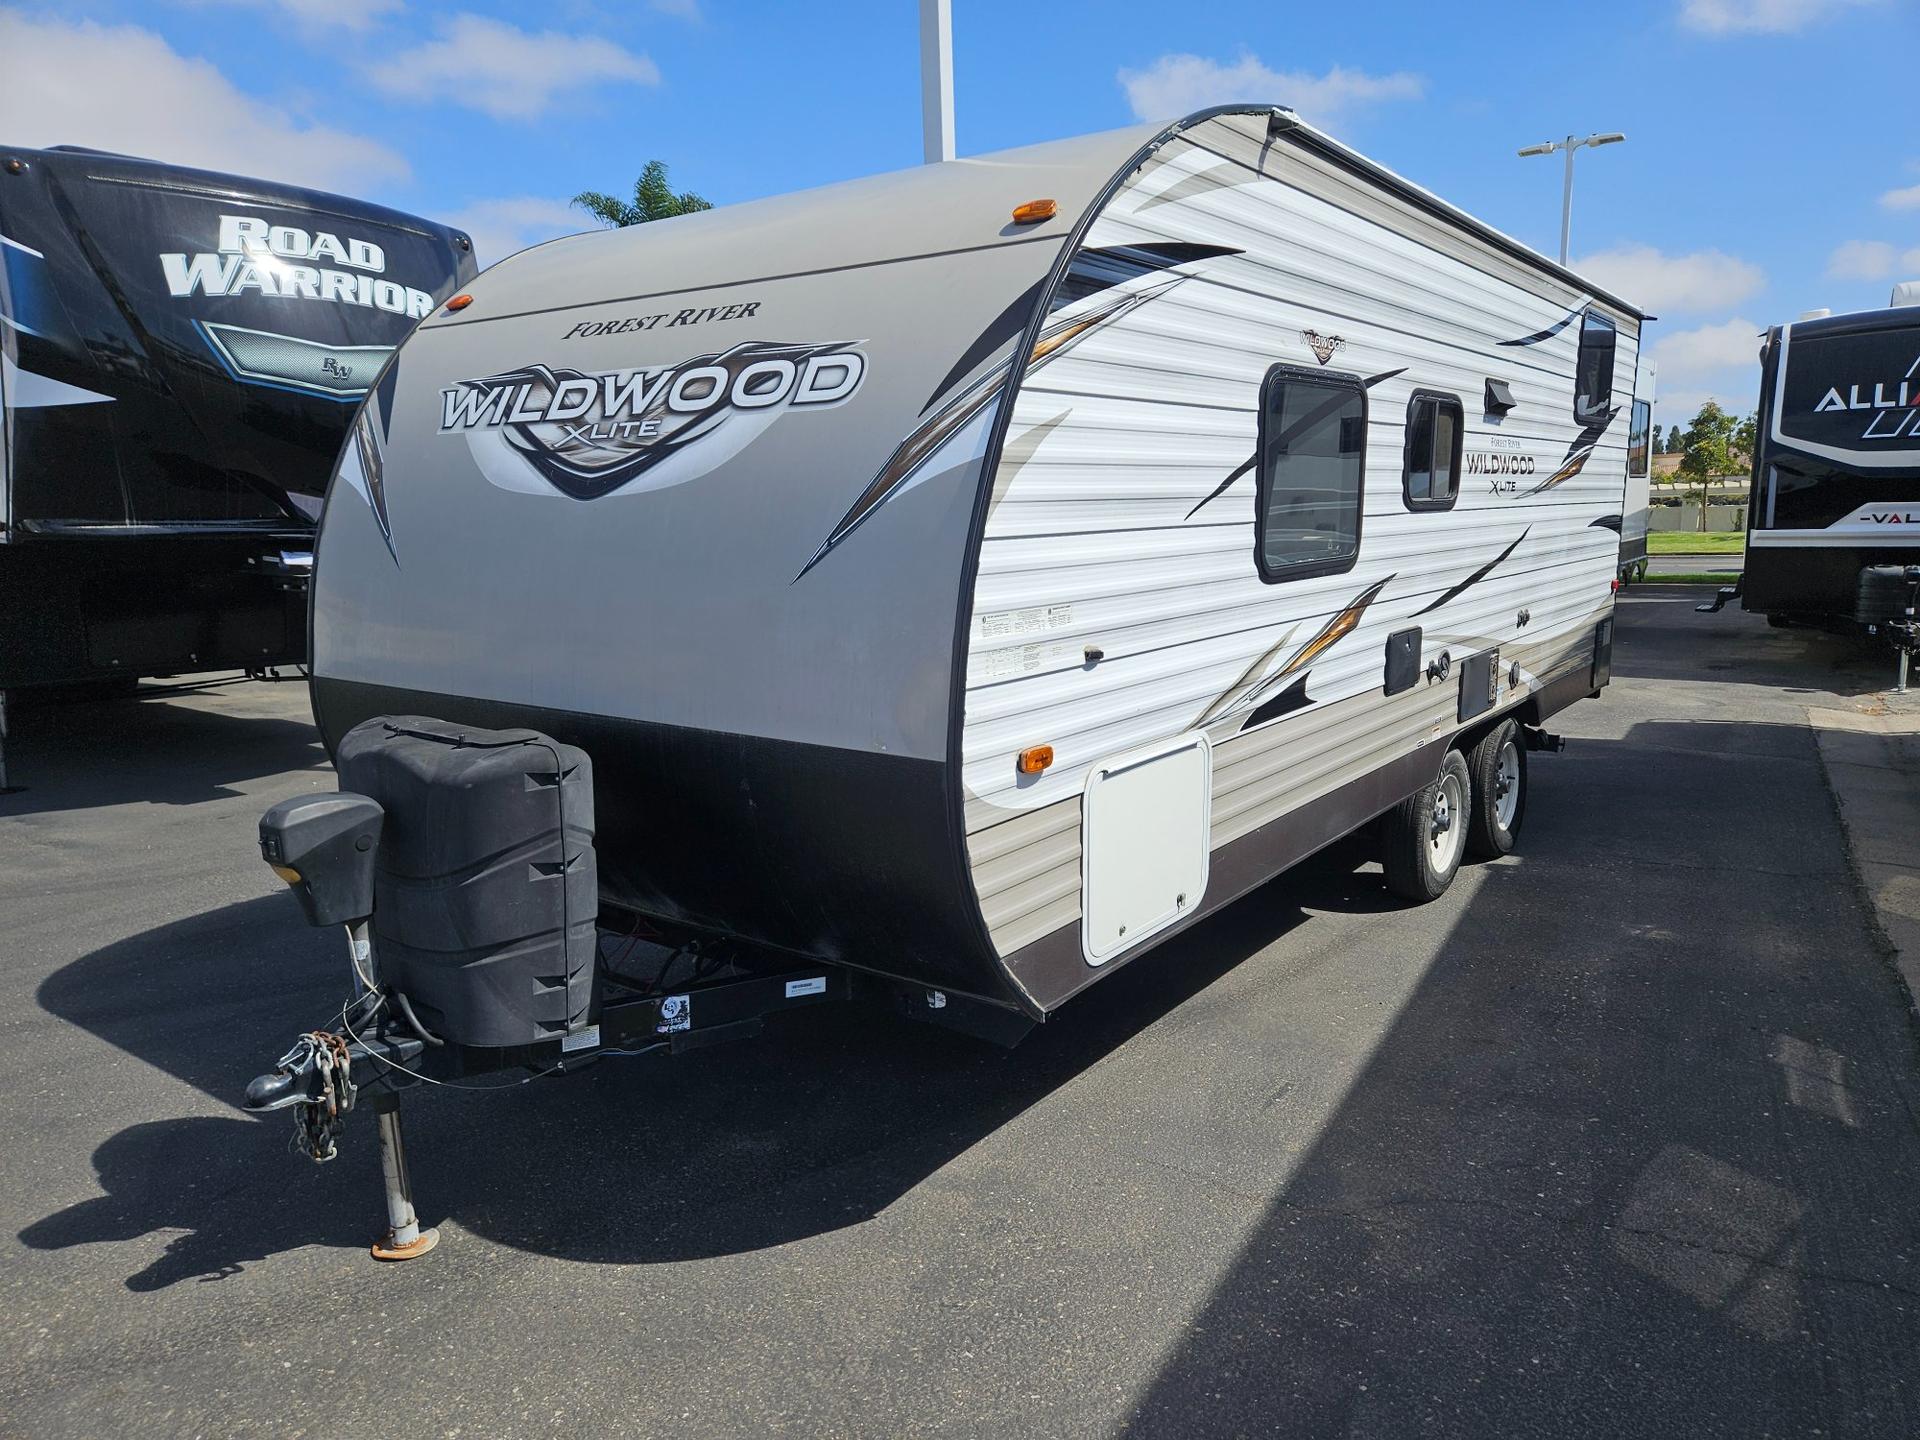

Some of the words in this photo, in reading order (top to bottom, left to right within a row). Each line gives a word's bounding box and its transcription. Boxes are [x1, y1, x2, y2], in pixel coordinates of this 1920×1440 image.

[217, 214, 386, 274] ROAD
[159, 253, 435, 320] WARRIOR
[561, 313, 669, 341] FOREST
[665, 301, 762, 328] RIVER
[442, 352, 865, 431] WILDWOOD
[1466, 453, 1535, 475] WILDWOOD
